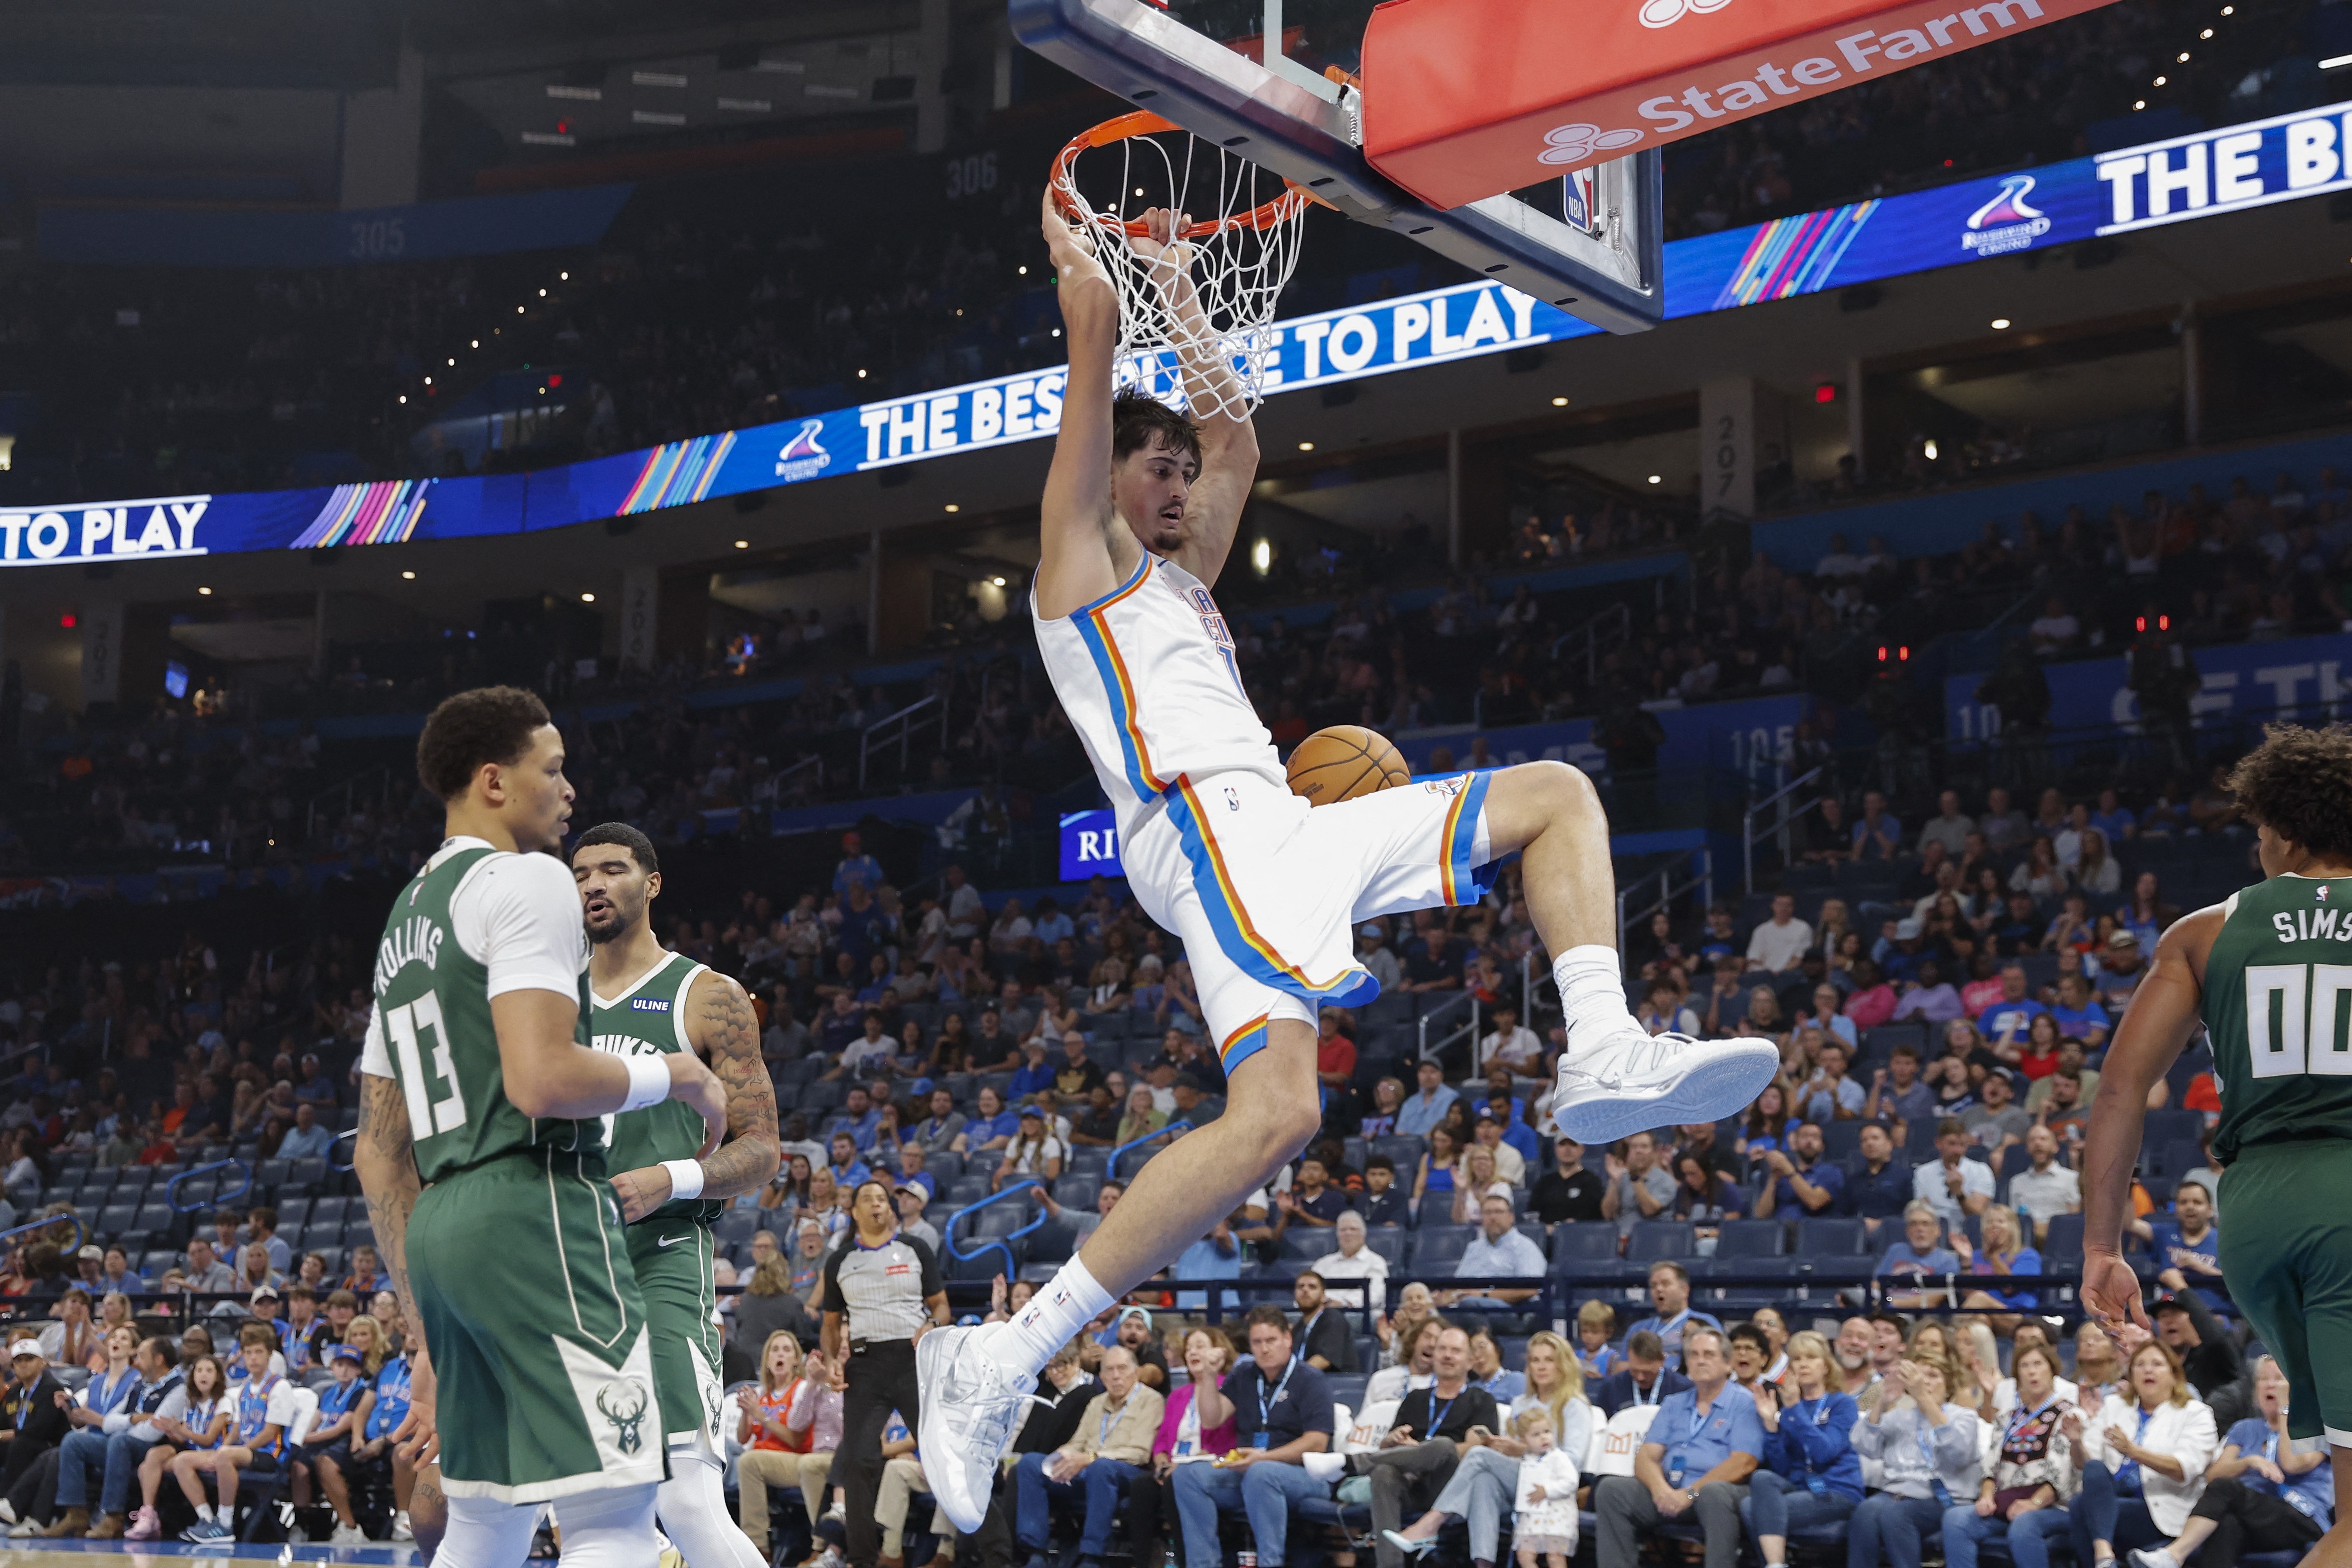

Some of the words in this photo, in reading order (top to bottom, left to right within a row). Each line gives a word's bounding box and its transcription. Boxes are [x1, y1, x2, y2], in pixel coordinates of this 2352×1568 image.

[946, 151, 998, 199] 306
[2098, 131, 2263, 224] THE
[2286, 111, 2352, 190] B
[351, 217, 406, 257] 305
[1568, 196, 1582, 221] NBA
[860, 394, 959, 461] THE
[972, 373, 1068, 442] BES
[1296, 315, 1377, 379] TO
[1393, 285, 1536, 362] PLAY
[1717, 415, 1736, 496] 207
[0, 512, 69, 560] TO
[81, 502, 207, 556] PLAY
[1956, 703, 2002, 744] 10
[2272, 908, 2352, 943] SIMS
[374, 915, 443, 996] ROLLINS
[633, 999, 669, 1011] ULINE
[2245, 964, 2352, 1078] 00
[386, 989, 466, 1141] 13
